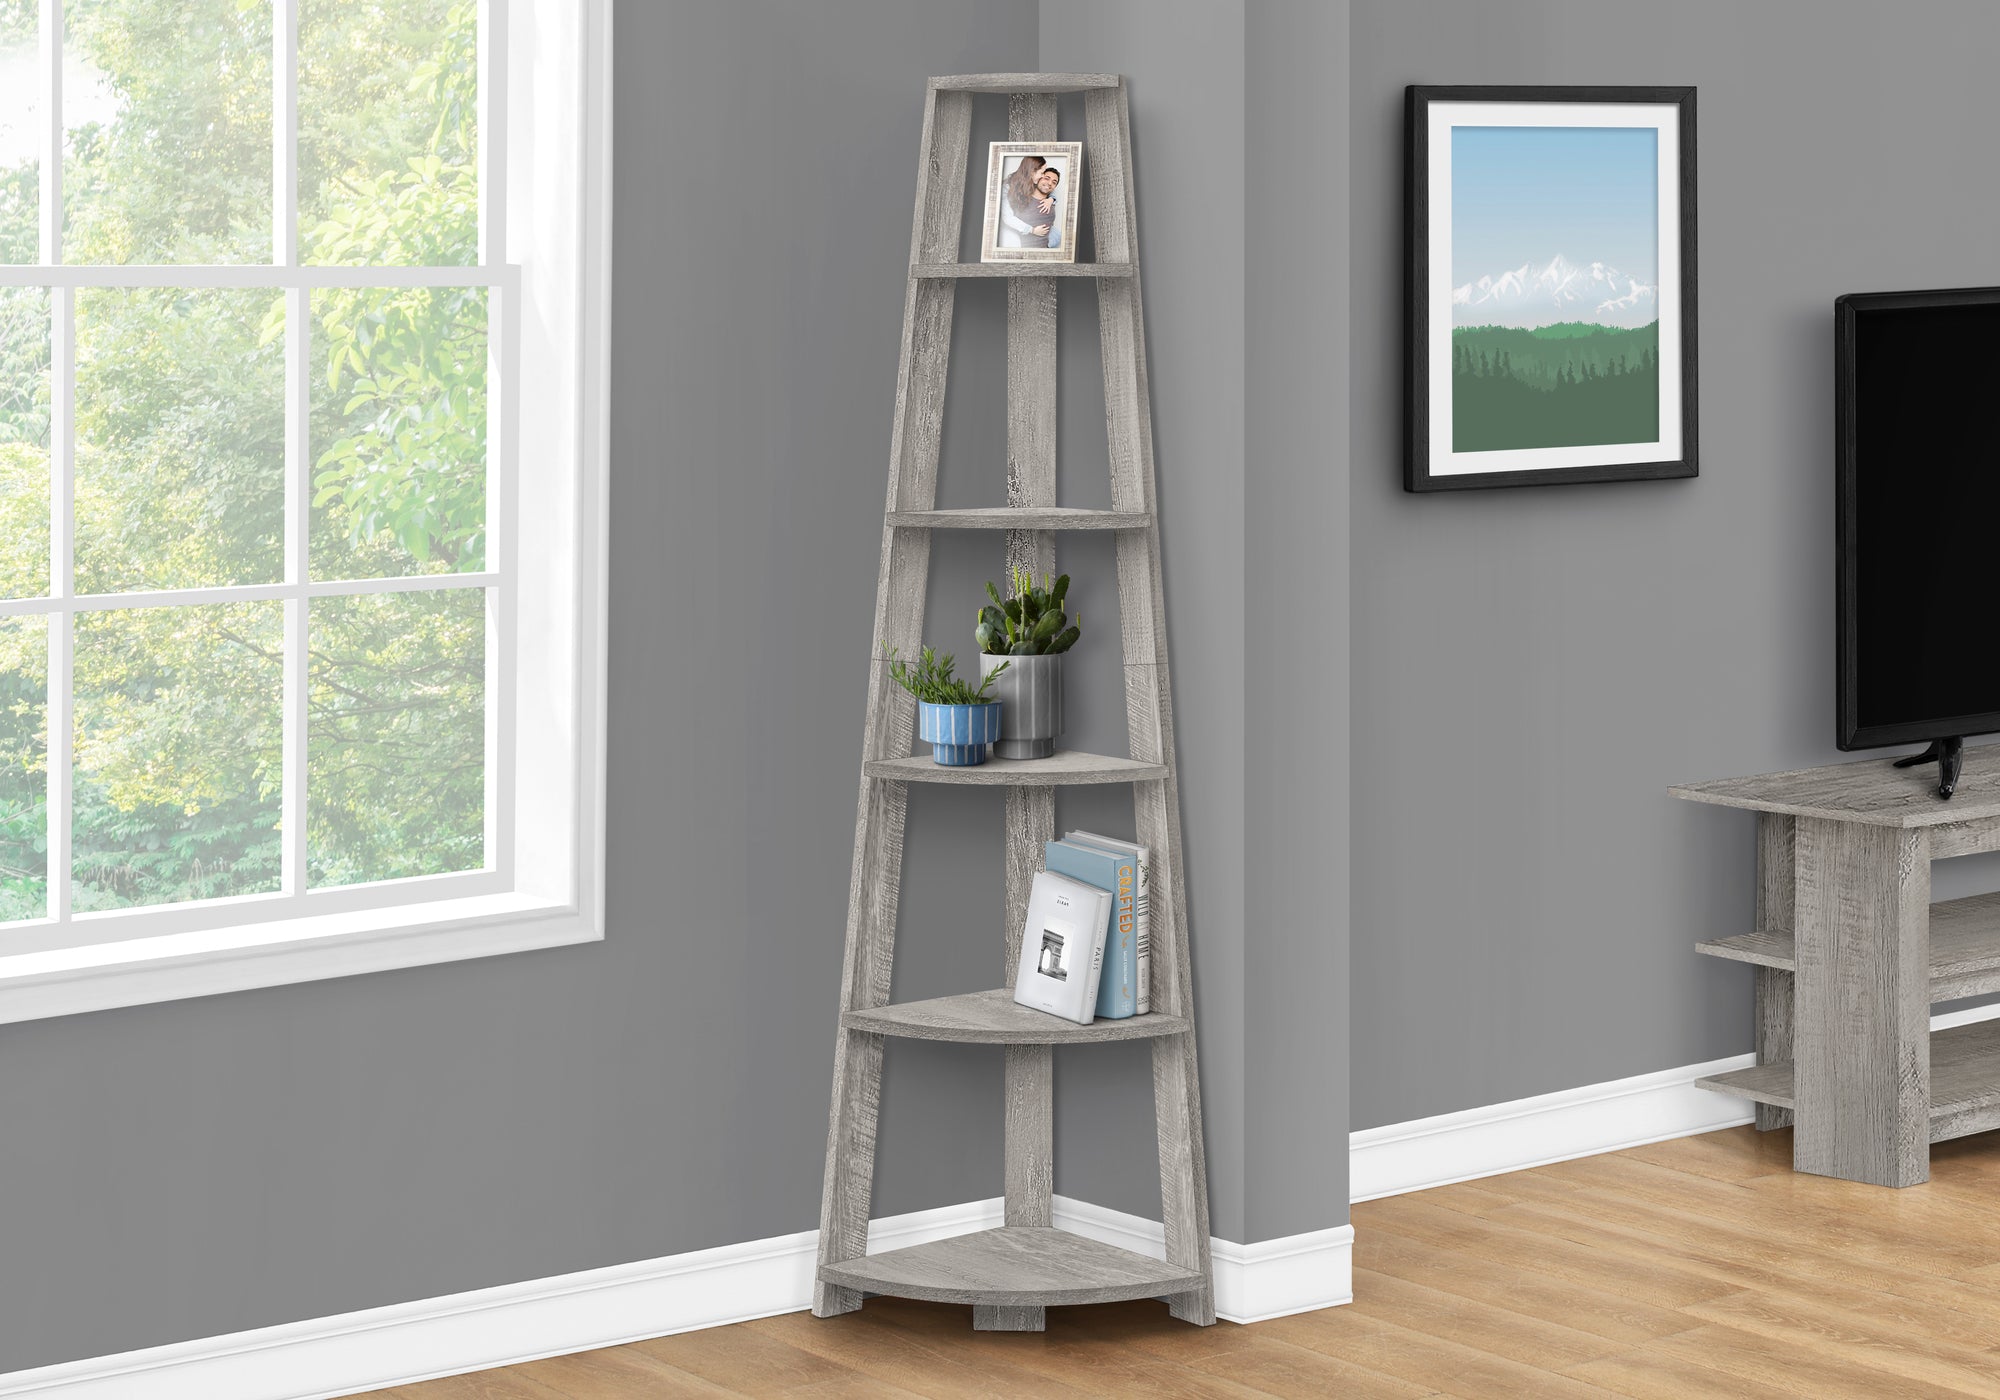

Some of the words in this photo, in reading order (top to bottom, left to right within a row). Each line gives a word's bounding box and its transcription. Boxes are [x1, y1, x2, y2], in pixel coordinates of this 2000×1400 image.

[1119, 865, 1133, 934] CRAFTED
[1138, 894, 1149, 917] WILD
[1092, 946, 1102, 971] PARIS
[1138, 933, 1149, 960] HOME
